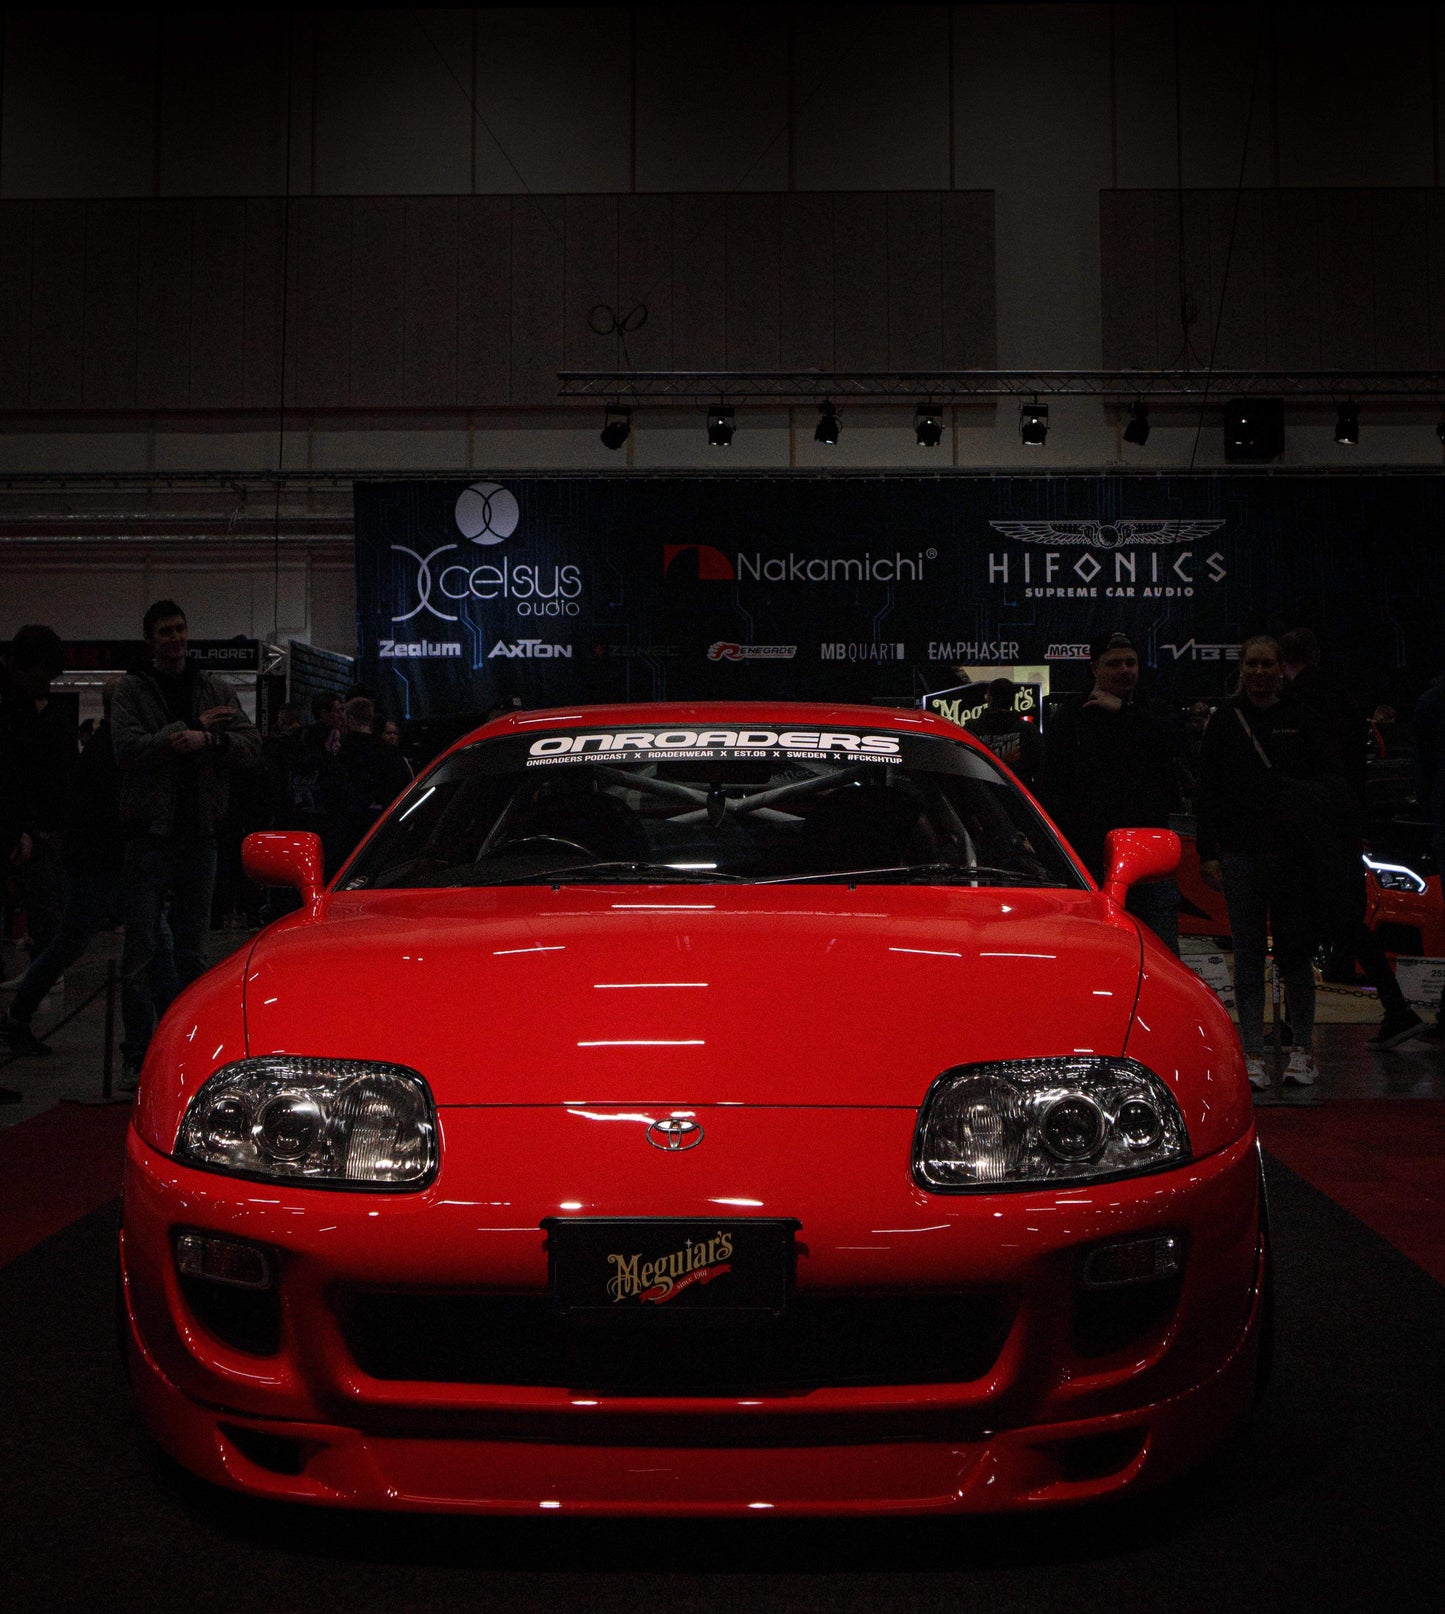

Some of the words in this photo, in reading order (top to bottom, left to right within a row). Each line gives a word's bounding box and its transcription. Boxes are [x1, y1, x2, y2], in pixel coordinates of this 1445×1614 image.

[988, 551, 1228, 583] HIFONICS
[1025, 587, 1098, 598] SUPREME
[1106, 587, 1136, 597] CAR
[1143, 586, 1195, 597] AUDIO
[517, 599, 580, 616] audio
[379, 639, 462, 657] Zealum
[487, 639, 573, 658] AXTON
[708, 641, 797, 661] RENEGADE
[529, 731, 900, 756] ONROADERS
[526, 756, 582, 767] ONROADERS
[584, 753, 628, 761] PODCAST
[787, 751, 827, 759] SWEDEN
[847, 754, 902, 764] #FCKSHTUP
[606, 1230, 734, 1303] Meguiar's
[677, 1276, 693, 1290] since
[694, 1269, 708, 1280] 1901
